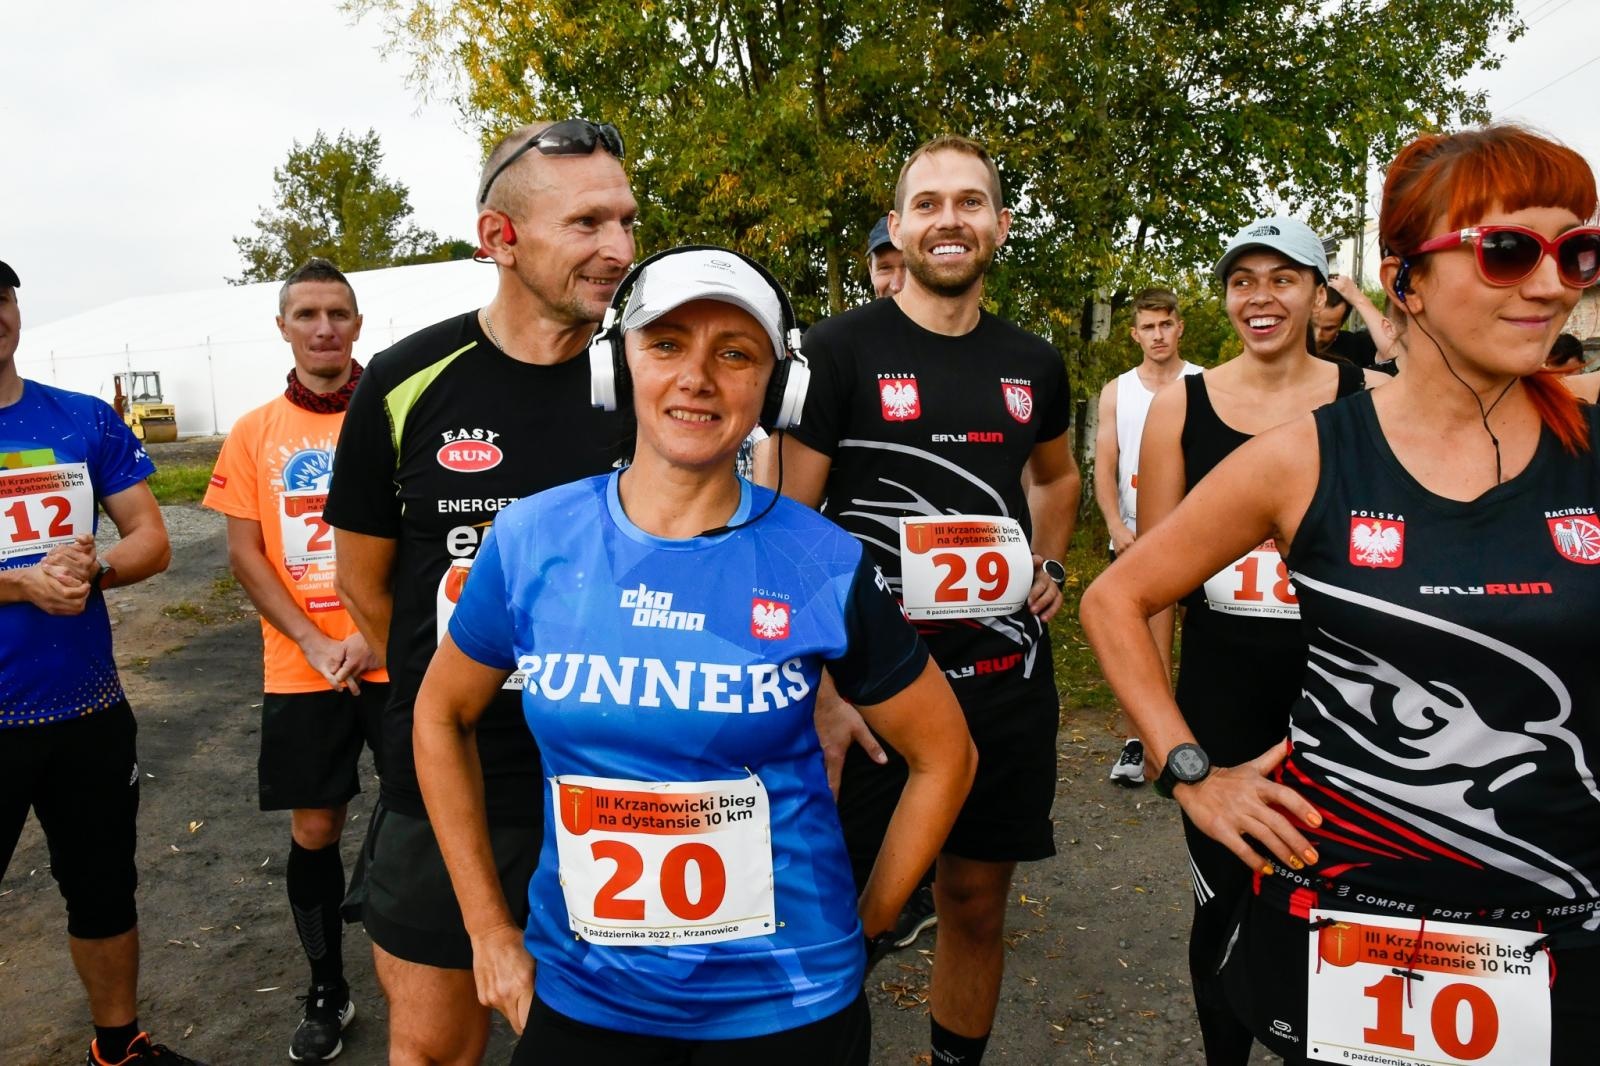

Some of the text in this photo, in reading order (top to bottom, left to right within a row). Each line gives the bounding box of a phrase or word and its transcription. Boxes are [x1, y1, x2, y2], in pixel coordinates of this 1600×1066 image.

[441, 428, 500, 444] EASY
[448, 450, 492, 461] RUN
[8, 473, 66, 485] Krzanowicki
[67, 471, 84, 479] bieg
[15, 482, 60, 494] dystansie
[4, 496, 73, 542] 12
[1351, 510, 1404, 521] POLSKA
[1544, 506, 1596, 519] RACIBÓRZ
[935, 525, 1019, 536] III Krzanowicki bieg
[952, 535, 996, 545] dystansie
[931, 551, 1010, 603] 29
[752, 587, 790, 600] POLAND
[632, 609, 706, 631] okna
[518, 653, 810, 714] RUNNERS
[596, 795, 756, 813] III Krzanowicki bieg
[599, 809, 753, 830] na dystansie 10 km
[590, 839, 726, 921] 20
[583, 926, 588, 934] 8
[589, 928, 646, 939] października
[648, 930, 670, 939] 2022
[684, 925, 739, 937] Krzanowice
[1365, 931, 1534, 962] III Krzanowicki bieg
[1368, 948, 1531, 975] na dystansie 10 km
[1363, 975, 1499, 1060] 10
[1343, 1050, 1350, 1058] 8
